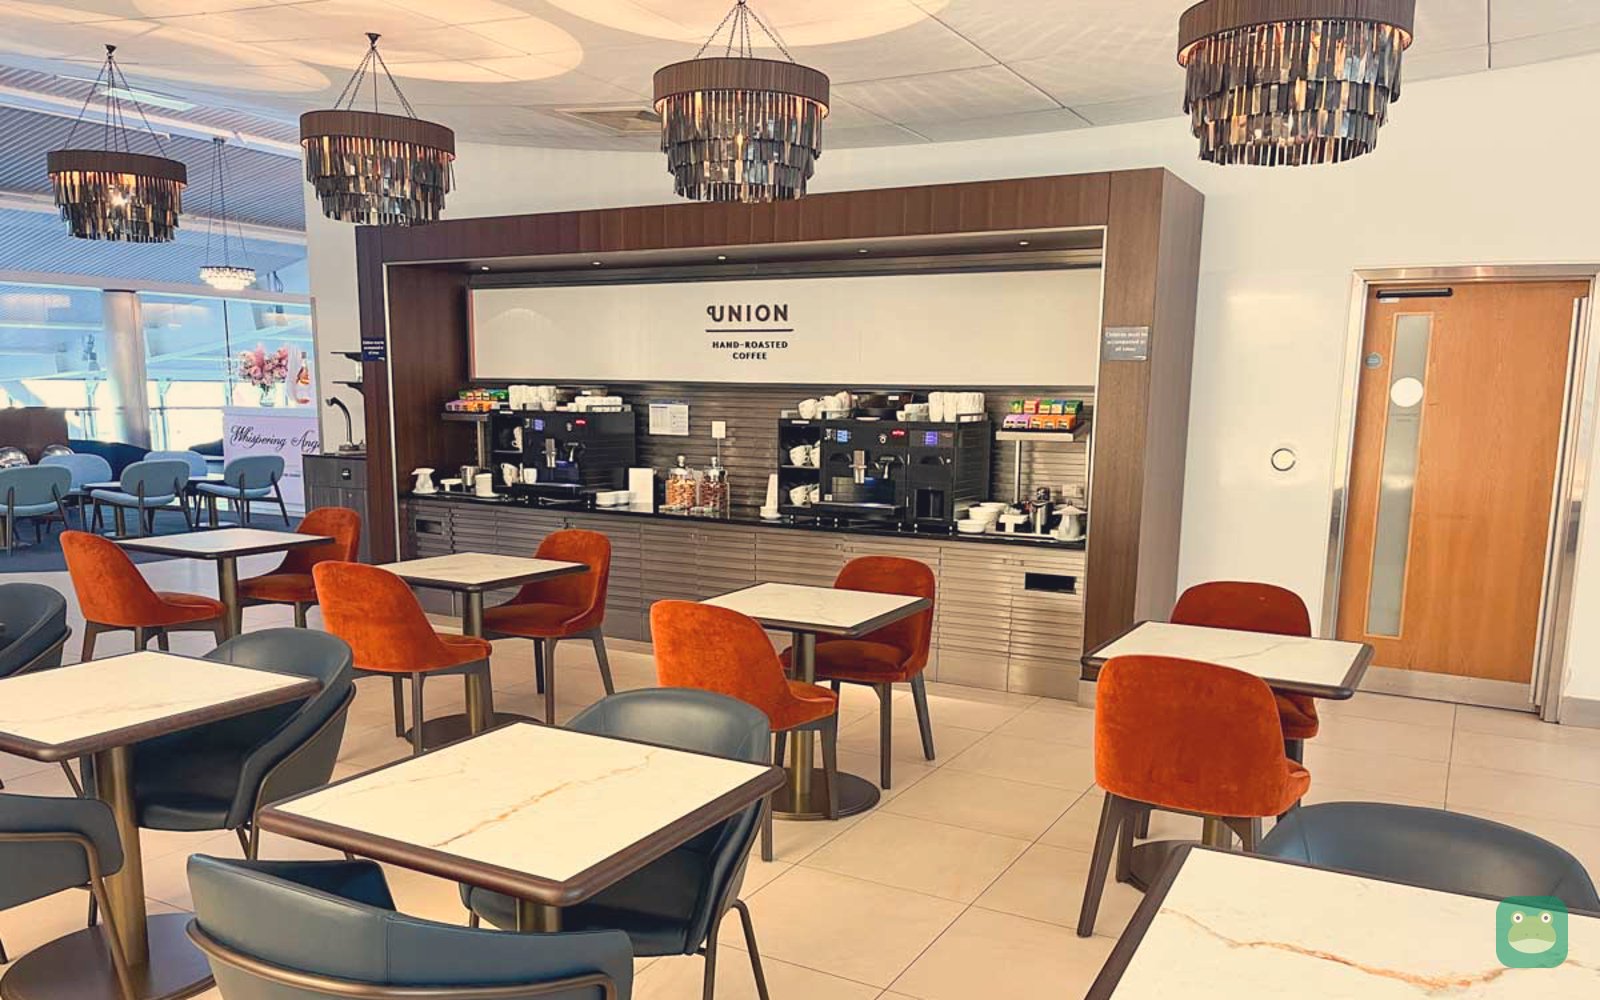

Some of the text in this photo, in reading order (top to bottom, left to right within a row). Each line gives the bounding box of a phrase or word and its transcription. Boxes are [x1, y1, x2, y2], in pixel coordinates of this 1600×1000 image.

[706, 304, 788, 322] UNION
[712, 340, 789, 349] HAND-ROASTED
[732, 352, 767, 360] COFFEE
[230, 425, 287, 452] Whispering
